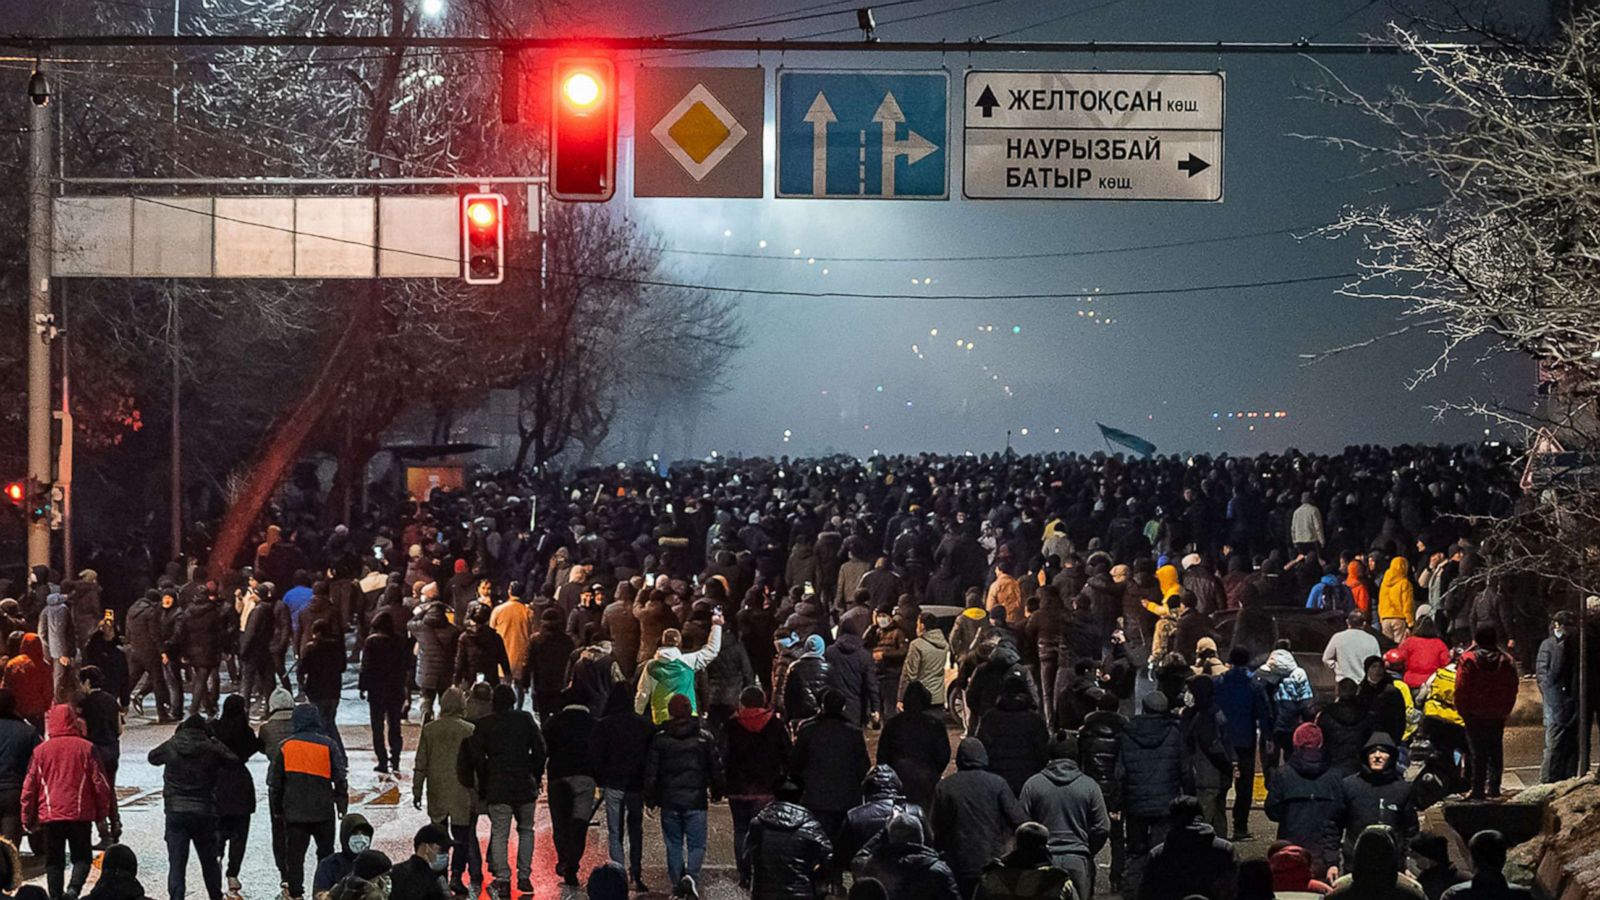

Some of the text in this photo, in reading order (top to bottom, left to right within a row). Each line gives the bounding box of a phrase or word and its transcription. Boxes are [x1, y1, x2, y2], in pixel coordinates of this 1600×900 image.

[1008, 89, 1199, 115] ЖЕЛТОҚСАН көш.
[1006, 136, 1161, 161] НАУРЫЗБАЙ
[1006, 167, 1133, 190] БАТЫР көш.
